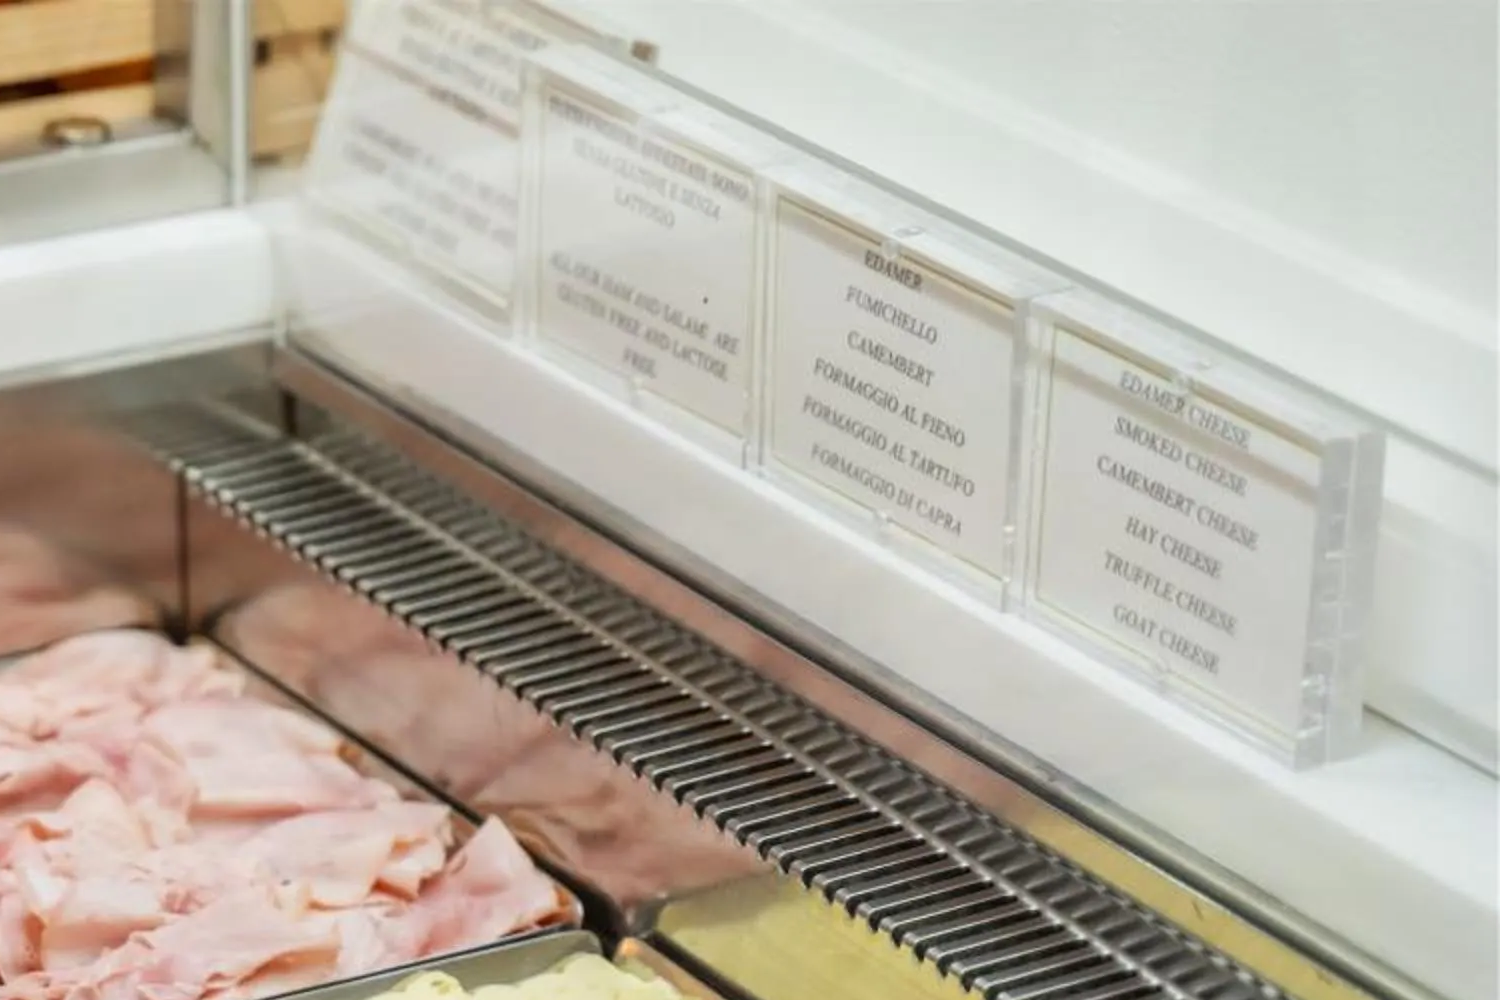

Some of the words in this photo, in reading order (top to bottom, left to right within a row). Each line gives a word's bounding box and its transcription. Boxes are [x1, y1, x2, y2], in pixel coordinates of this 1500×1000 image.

[864, 250, 924, 293] EDAMER
[714, 331, 740, 356] ARE
[846, 285, 938, 345] FUMICHELLO
[847, 330, 935, 388] CAMEMBERT
[813, 357, 899, 414] FORMAGGIO
[900, 404, 918, 426] AL
[920, 411, 966, 448] FIENO
[1120, 371, 1185, 415] EDAMER
[1189, 404, 1251, 450] CHEESE
[802, 394, 887, 451] FORMAGGIO
[889, 441, 906, 464] AL
[910, 449, 975, 498] TARTUFO
[1114, 415, 1183, 463] SMOKED
[1185, 451, 1248, 498] CHEESE
[811, 443, 896, 500] FORMAGGIO
[897, 488, 915, 512] DI
[916, 499, 963, 537] CAPRA
[1097, 455, 1196, 517] CAMEMBERT
[1197, 505, 1259, 551] CHEESE
[1125, 515, 1159, 545] HAY
[1160, 533, 1223, 579] CHEESE
[1105, 549, 1175, 602] TRUFFLE
[1175, 590, 1238, 637] CHEESE
[1113, 604, 1157, 638] GOAT
[1159, 627, 1220, 675] CHEESE
